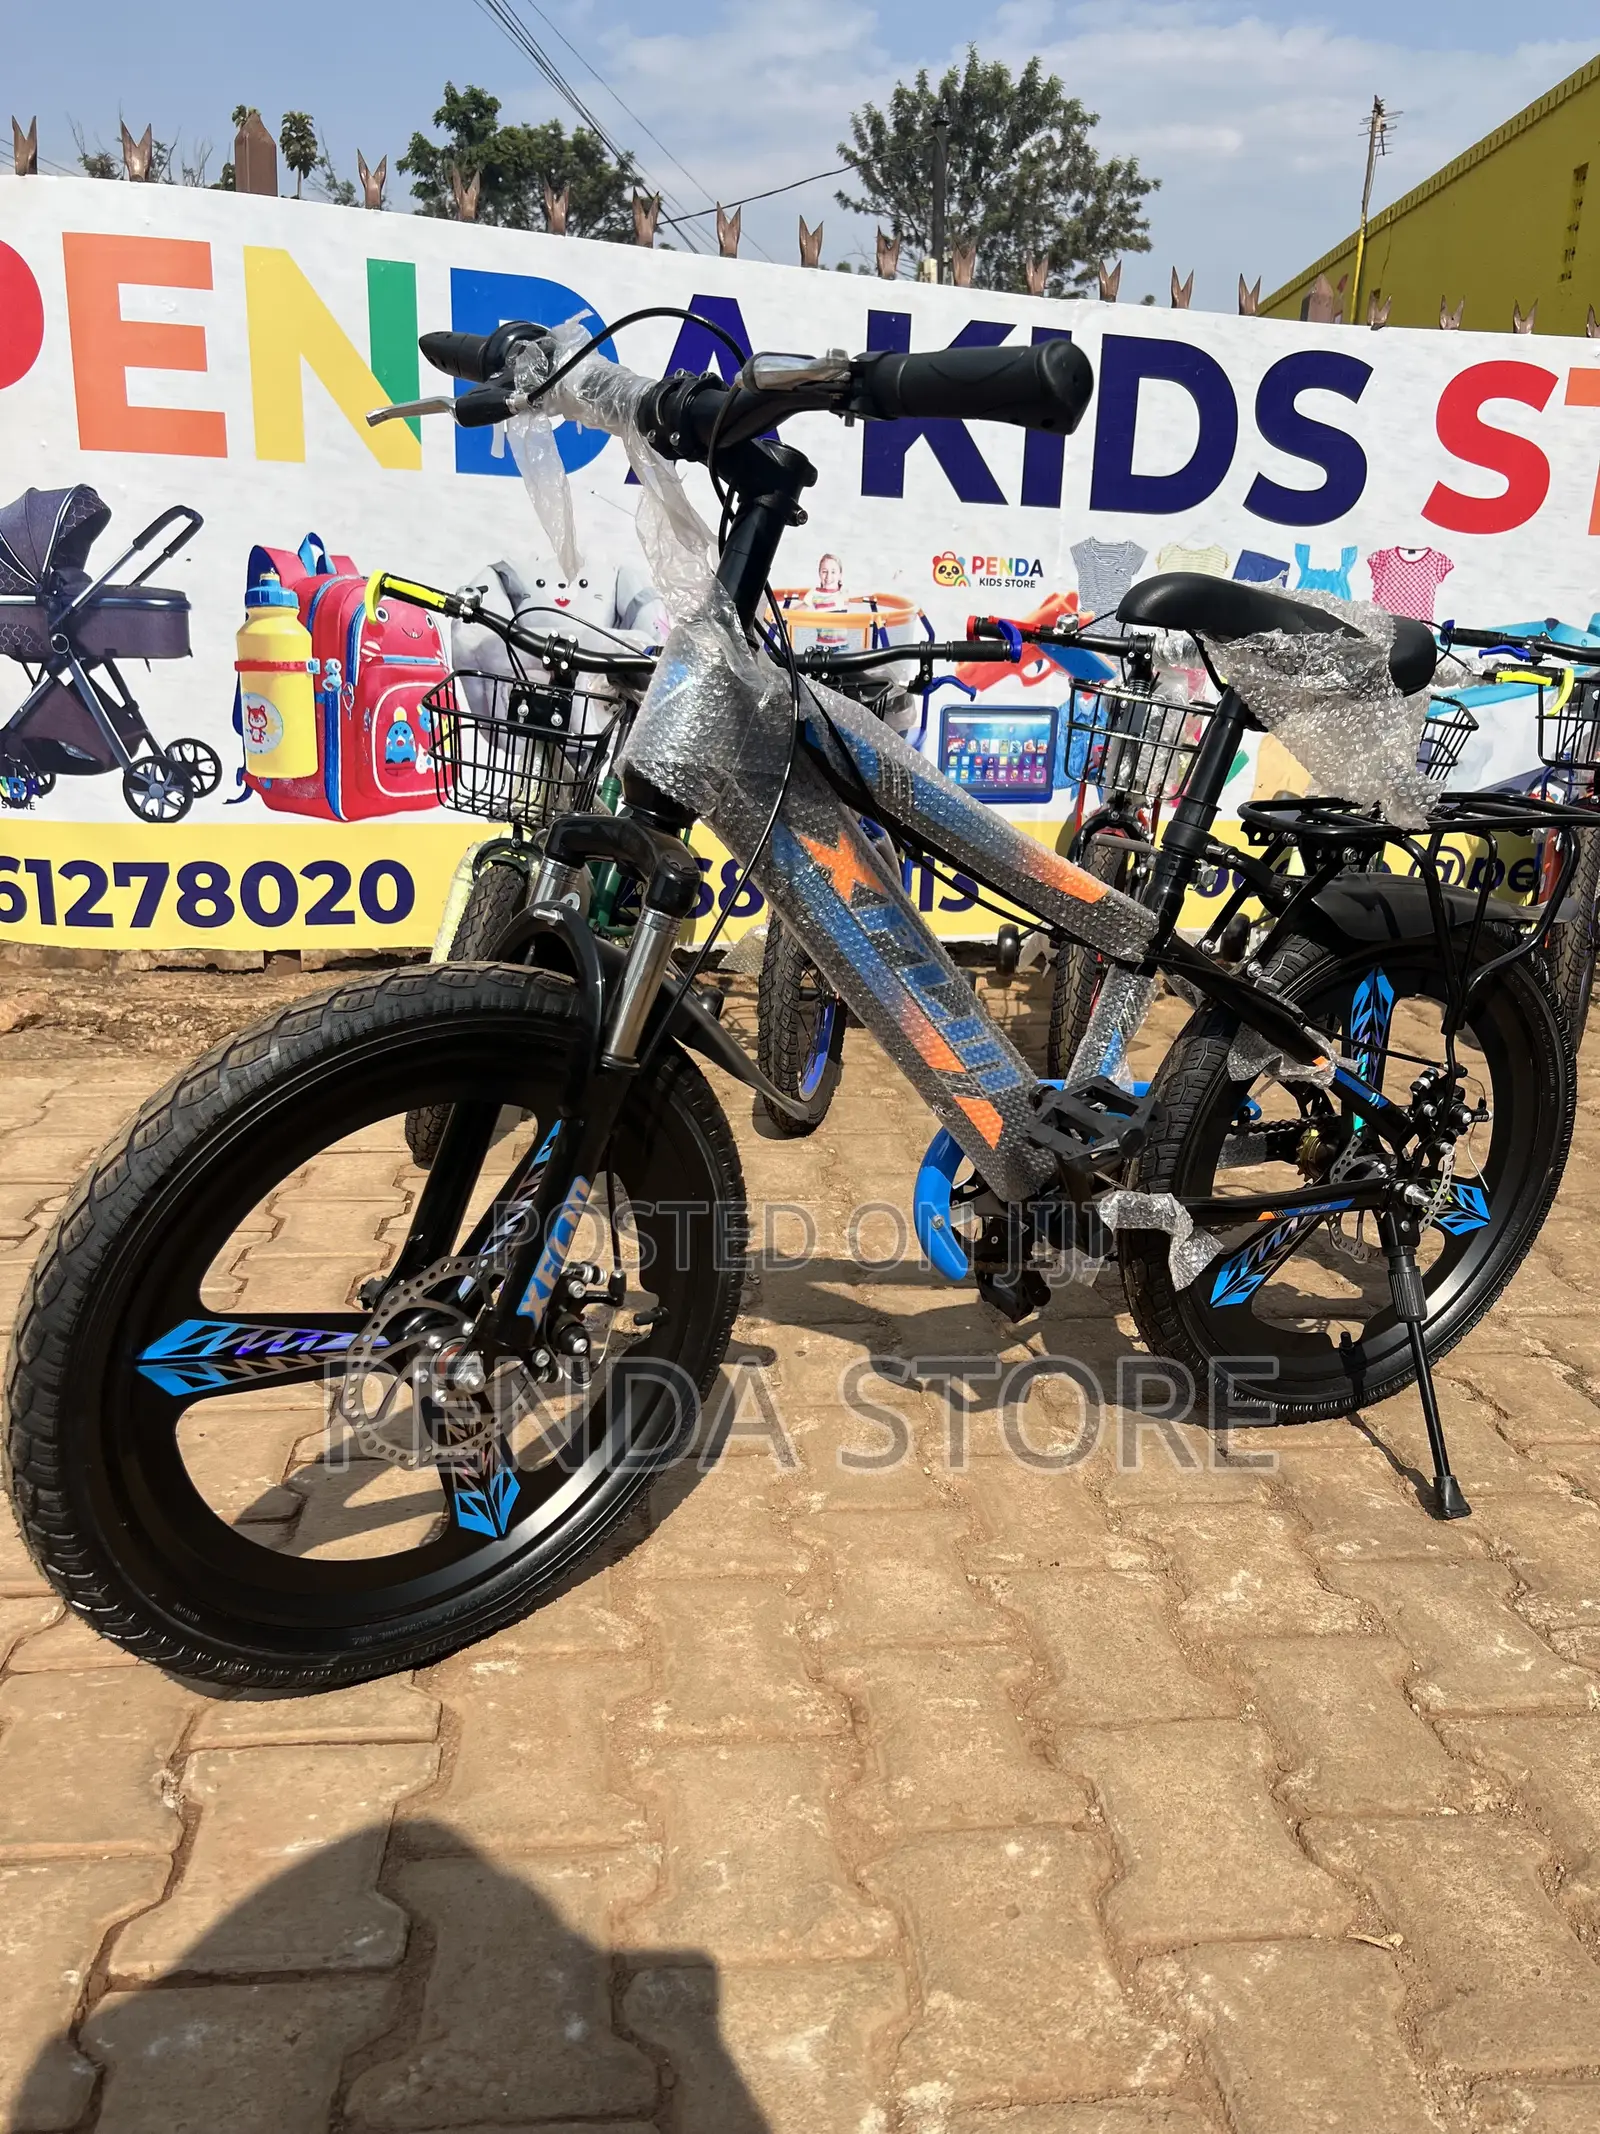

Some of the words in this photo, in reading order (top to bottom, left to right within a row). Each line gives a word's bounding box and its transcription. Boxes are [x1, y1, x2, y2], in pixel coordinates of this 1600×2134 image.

[861, 309, 1373, 527] KIDS
[971, 556, 1044, 578] PENDA
[979, 578, 1002, 587] KIDS
[1004, 579, 1036, 588] STORE
